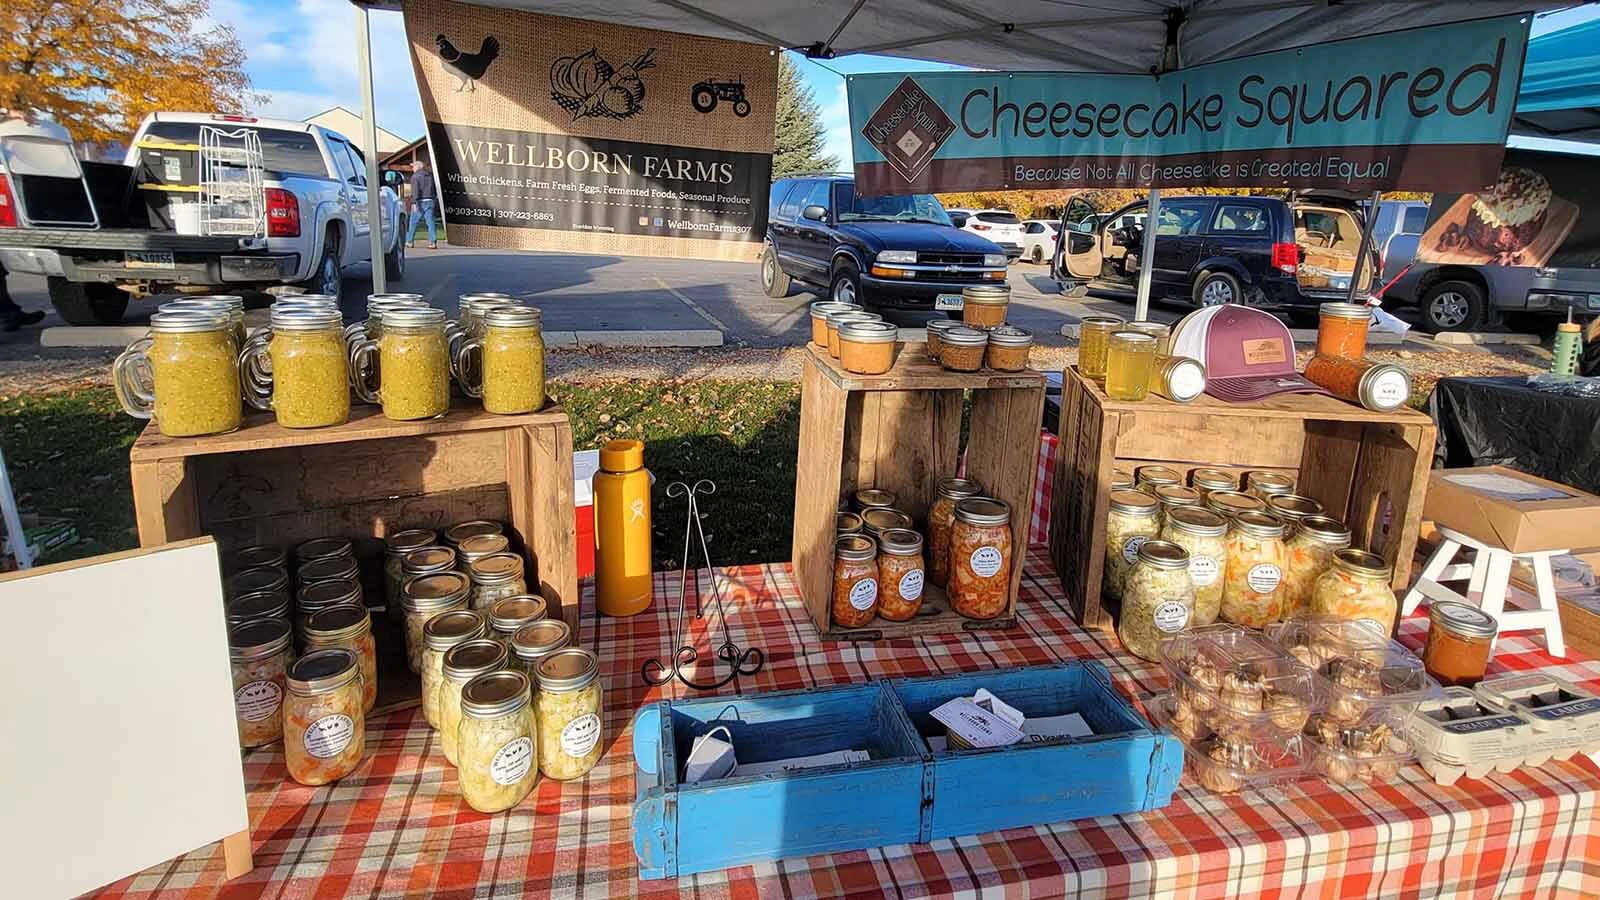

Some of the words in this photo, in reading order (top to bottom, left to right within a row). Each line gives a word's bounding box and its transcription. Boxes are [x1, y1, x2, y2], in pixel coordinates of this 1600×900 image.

[960, 83, 1223, 139] Cheesecake
[1236, 37, 1507, 144] Squared
[867, 88, 923, 144] Cheesecake
[912, 99, 952, 143] Squared
[454, 138, 632, 176] WELLBORN
[643, 156, 734, 184] FARMS
[1014, 164, 1081, 182] Because
[1086, 163, 1112, 180] Not
[1116, 162, 1135, 179] All
[1235, 159, 1249, 177] is
[1251, 156, 1321, 178] Created
[1326, 155, 1392, 184] Equal
[448, 172, 478, 184] Whole
[479, 175, 524, 189] Chickens,
[526, 179, 550, 190] Farm
[552, 181, 577, 192] Fresh
[578, 183, 601, 196] Eggs,
[603, 185, 649, 198] Fermented
[651, 188, 678, 200] Foods,
[679, 191, 715, 202] Seasonal
[717, 194, 751, 205] Produce
